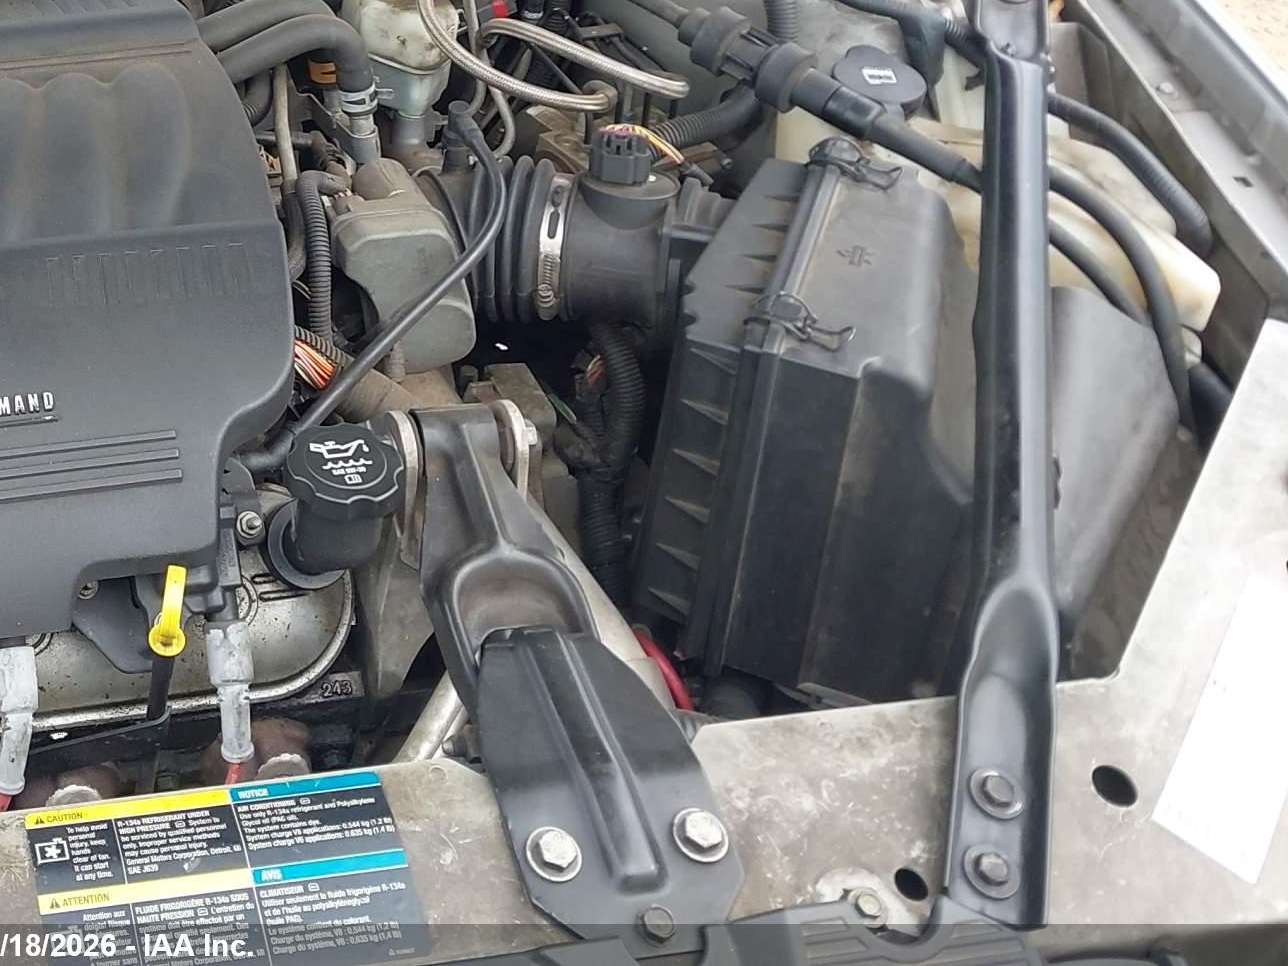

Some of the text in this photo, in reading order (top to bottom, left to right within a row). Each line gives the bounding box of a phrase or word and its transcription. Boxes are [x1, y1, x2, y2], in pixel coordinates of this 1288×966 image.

[322, 679, 353, 698] 243
[238, 788, 270, 799] NOTICE
[250, 800, 296, 810] CONDITIONING
[291, 804, 323, 813] refrigerant
[46, 813, 83, 823] CAUTION
[117, 810, 210, 828] R-134a REFRIGERANT UNDER
[241, 819, 261, 827] Glycol
[66, 823, 108, 834] To help avoid
[119, 827, 136, 835] HIGH
[136, 823, 171, 832] PRESSURE
[188, 818, 212, 827] System
[246, 834, 270, 842] System
[360, 820, 370, 828] kg
[257, 825, 279, 833] system
[281, 821, 307, 829] contains
[68, 832, 95, 843] personal
[121, 823, 227, 843] be serviced by qualified personnel
[139, 838, 168, 848] Improper
[168, 835, 192, 844] service
[192, 832, 221, 841] methods
[248, 841, 272, 851] System
[363, 828, 373, 836] kg
[71, 847, 91, 856] hands
[140, 847, 159, 855] cause
[160, 843, 187, 854] personal
[72, 855, 89, 864] clear
[126, 856, 150, 866] General
[151, 853, 172, 863] Motors
[210, 846, 232, 855] Detroit,
[93, 861, 109, 870] start
[127, 864, 159, 875] SAE J639
[84, 873, 96, 881] any
[97, 870, 113, 879] time.
[261, 869, 283, 881] AVIS
[260, 885, 304, 898] CLIMATISEUR
[62, 893, 110, 907] ATTENTION
[135, 905, 159, 914] FLUIDE
[205, 895, 230, 906] R-134a
[230, 893, 249, 901] SOUS
[262, 899, 285, 907] Utiliser
[286, 894, 320, 904] seulement
[327, 890, 346, 898] fluide
[83, 912, 113, 922] Attention
[137, 915, 160, 924] HAUTE
[160, 909, 194, 921] PRESSION
[210, 904, 245, 914] L'entretien
[264, 909, 271, 917] et
[223, 915, 235, 924] par
[271, 937, 294, 945] Charge
[295, 934, 304, 942] du
[273, 946, 296, 954] Charge
